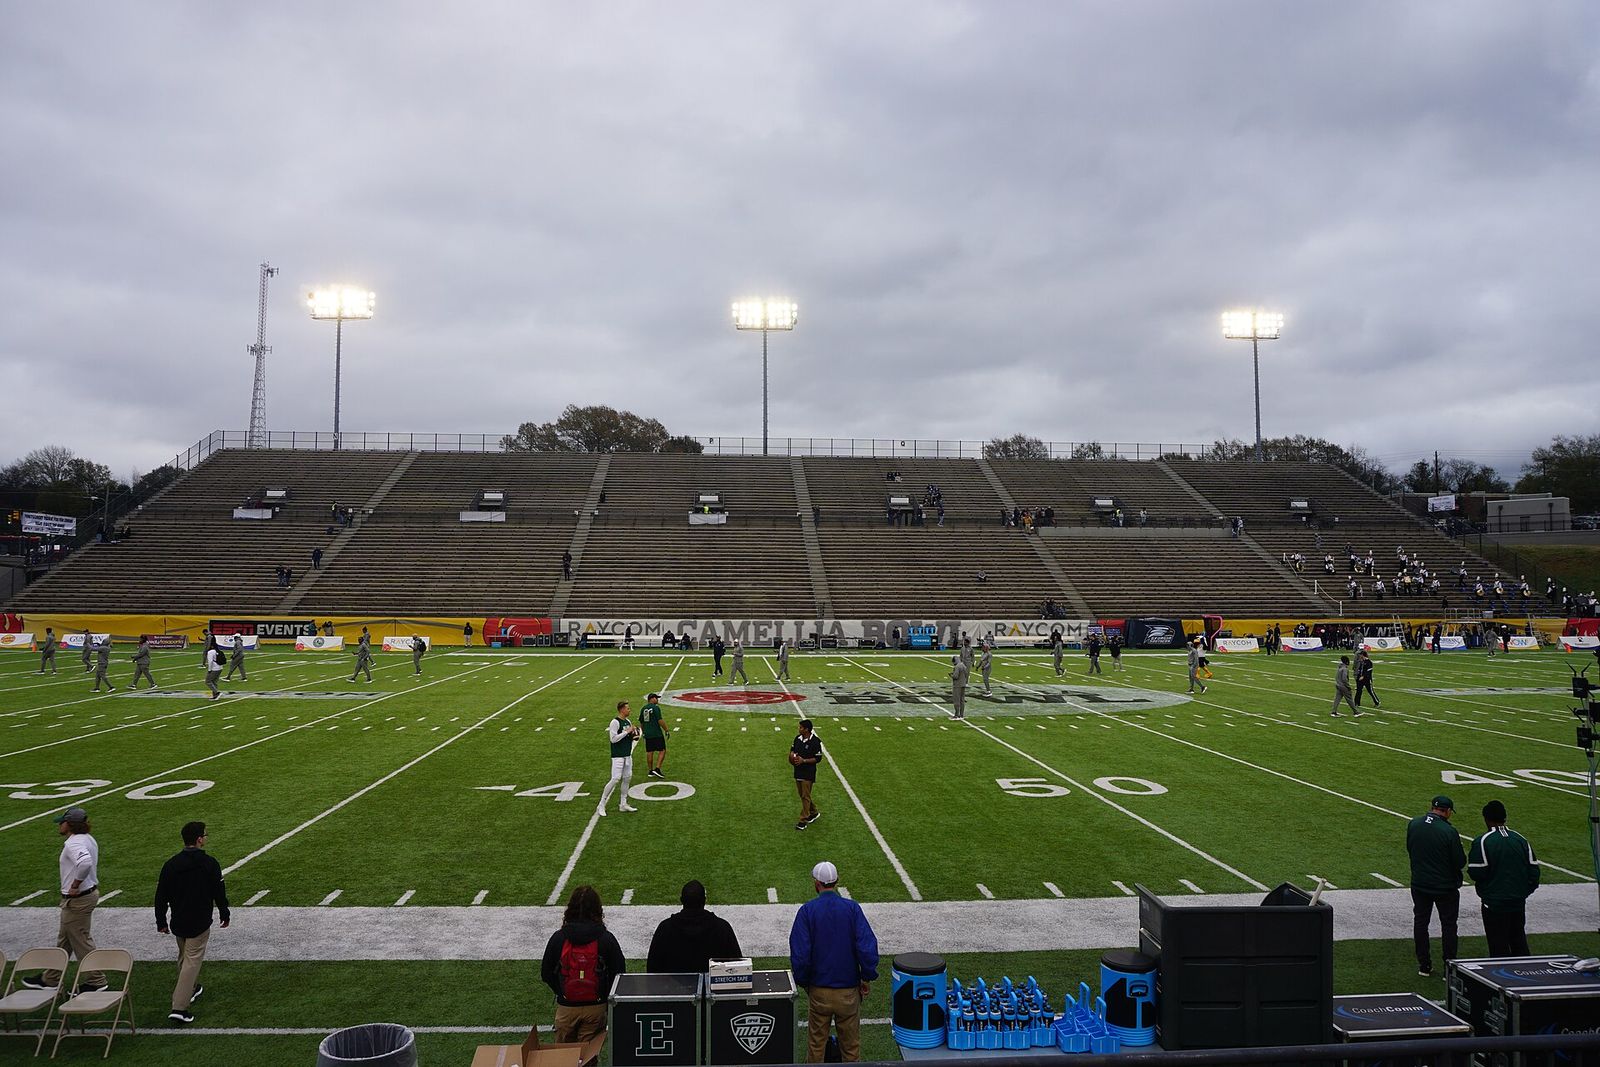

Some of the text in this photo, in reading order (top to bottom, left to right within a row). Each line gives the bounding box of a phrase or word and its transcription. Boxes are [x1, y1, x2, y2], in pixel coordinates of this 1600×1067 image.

[568, 621, 661, 636] RAYCOM
[994, 622, 1082, 636] RAYCOM
[1425, 816, 1434, 824] E
[1513, 968, 1578, 977] CoachCom
[1352, 1004, 1424, 1014] CoachComm
[635, 1012, 674, 1057] E
[736, 1025, 771, 1036] MAC
